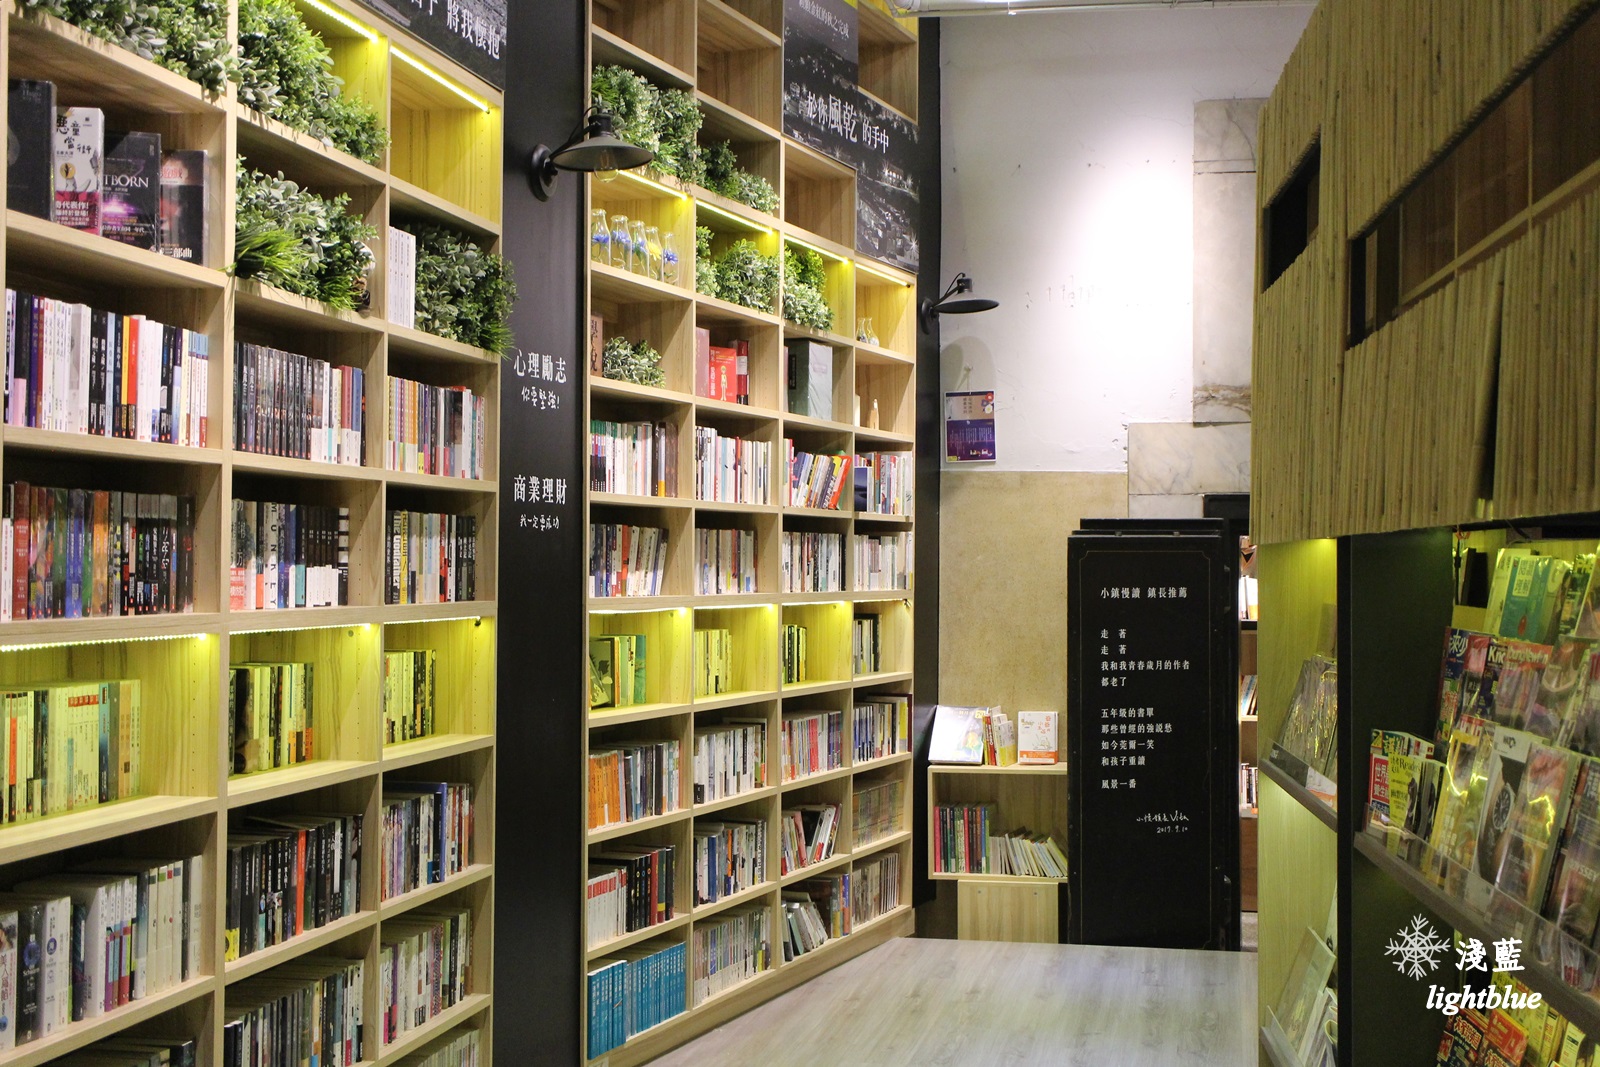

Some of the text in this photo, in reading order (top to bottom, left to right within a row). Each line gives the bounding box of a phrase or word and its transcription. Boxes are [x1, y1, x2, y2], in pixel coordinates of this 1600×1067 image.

[103, 174, 150, 188] TBORN
[513, 349, 567, 384] 心理勵志
[513, 474, 567, 505] 商業理財
[1100, 586, 1188, 599] 小鎮慢讀 鎮長推薦
[1100, 676, 1127, 687] 都老了
[1100, 707, 1154, 718] 五年級的書單
[1100, 739, 1155, 750] 如今莞爾一笑
[1101, 755, 1146, 766] 和孩子重讀
[1101, 778, 1137, 789] 風景一番
